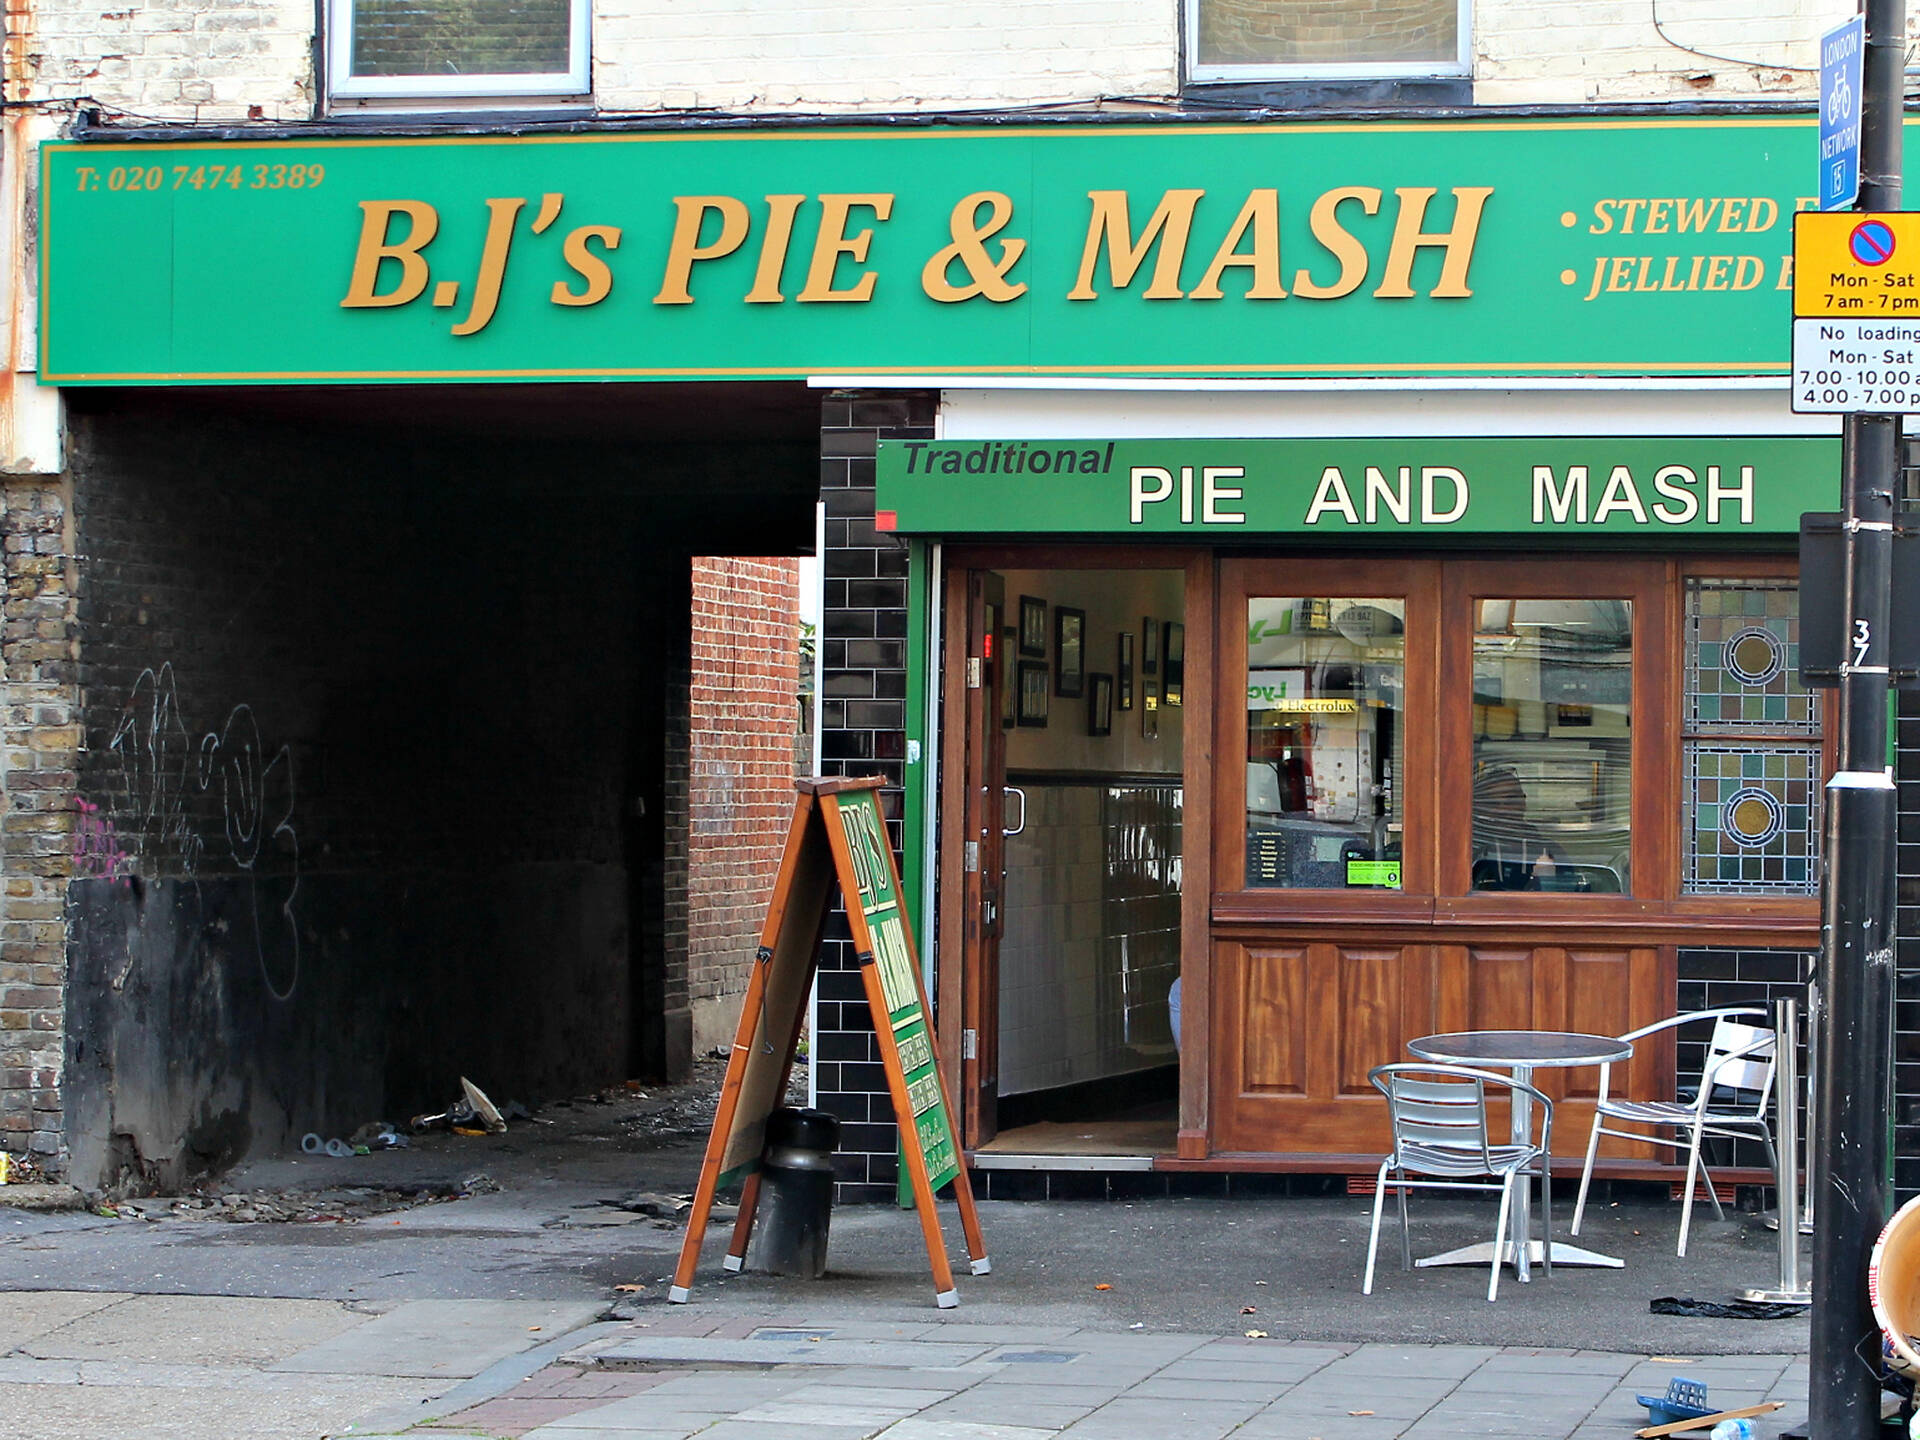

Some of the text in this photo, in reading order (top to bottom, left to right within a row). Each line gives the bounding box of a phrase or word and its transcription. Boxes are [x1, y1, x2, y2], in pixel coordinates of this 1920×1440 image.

[1825, 31, 1858, 68] LONDON
[1822, 124, 1857, 161] NETWORK
[76, 163, 325, 191] T: 020 7474 3389
[1588, 196, 1779, 235] STEWED
[339, 186, 1495, 337] B.J's PIE & MASH
[1583, 255, 1766, 302] JELLIED
[1830, 273, 1868, 288] Mon
[1883, 273, 1915, 288] Sat
[1820, 326, 1845, 341] No
[1829, 350, 1867, 364] Mon
[1882, 350, 1914, 364] Sat
[1800, 371, 1842, 385] 7.00
[1857, 371, 1911, 385] 10.00
[1803, 389, 1849, 404] 4.00
[1863, 389, 1906, 404] 7.00
[901, 441, 1115, 476] Traditional
[1130, 465, 1754, 525] PIE AND MASH
[1287, 701, 1356, 713] Electrolux
[1868, 1264, 1879, 1309] FRAGILE
